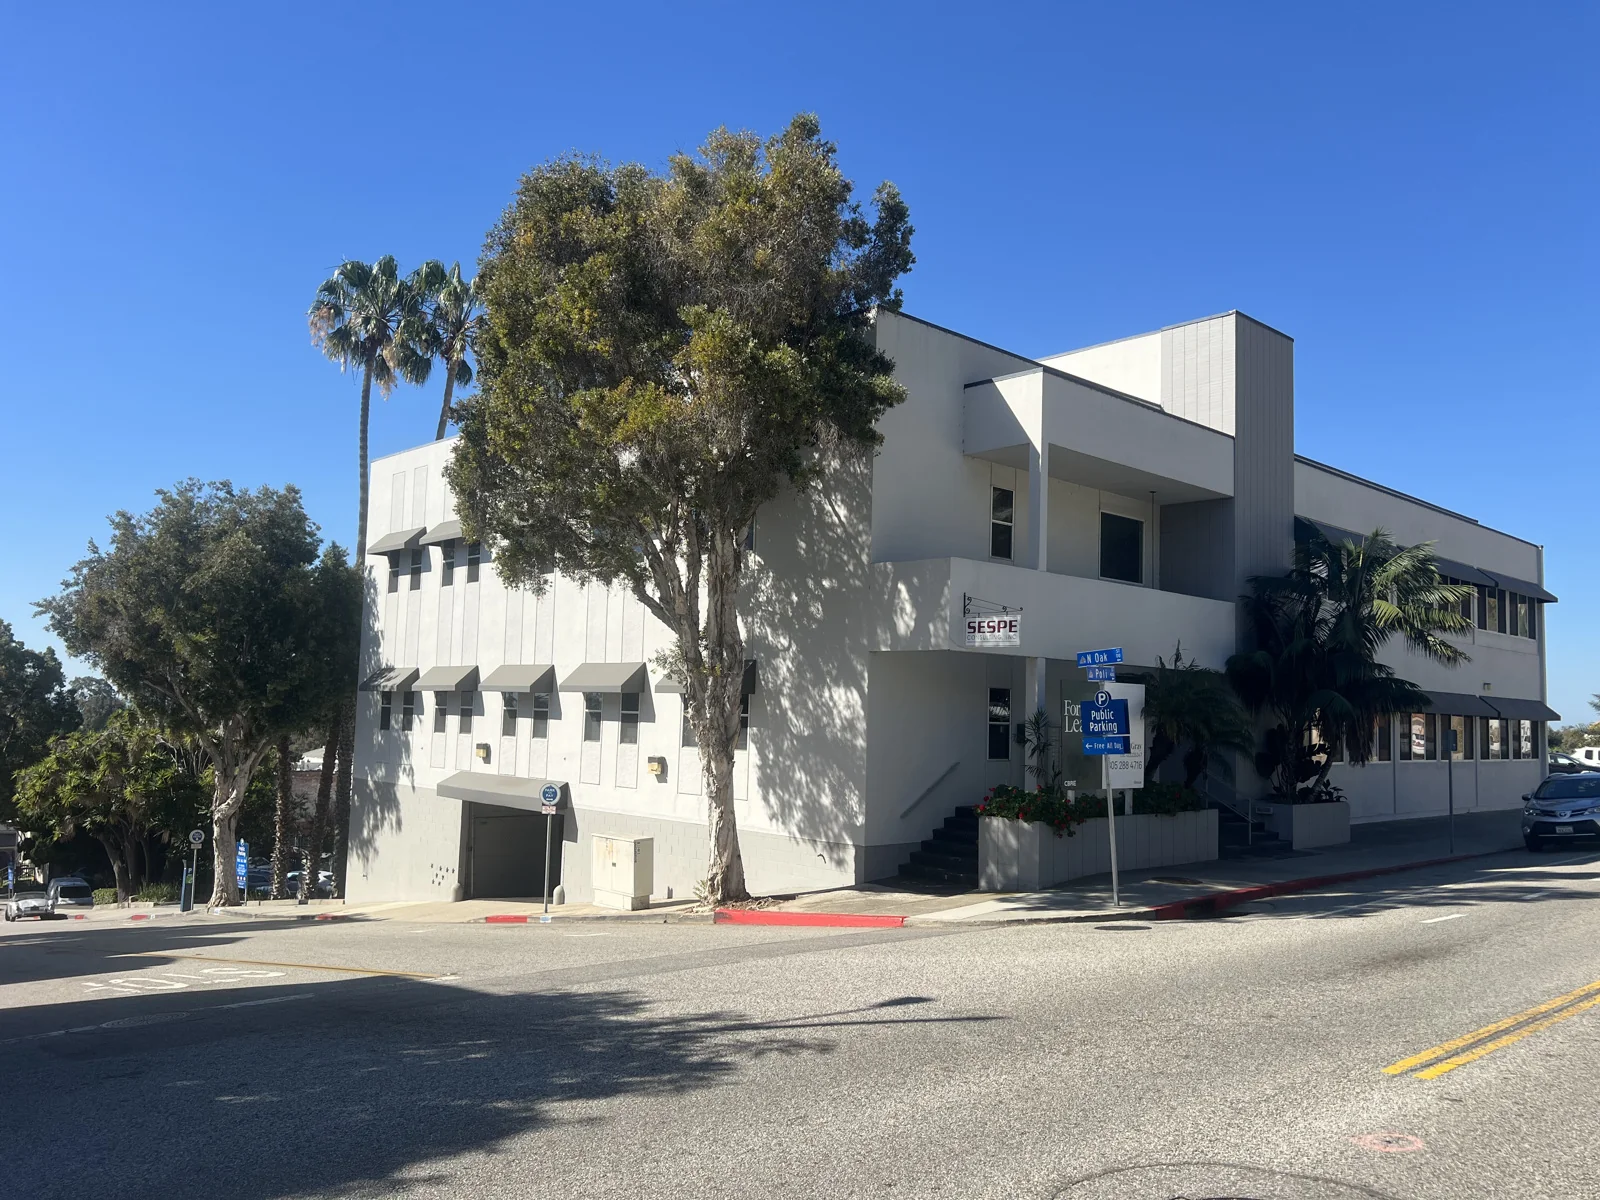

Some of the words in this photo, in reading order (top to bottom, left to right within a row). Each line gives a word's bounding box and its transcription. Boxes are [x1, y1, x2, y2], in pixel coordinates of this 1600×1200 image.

[967, 620, 1018, 634] SESPE
[1086, 653, 1092, 664] N
[1094, 652, 1108, 663] Oak
[1095, 668, 1108, 679] Poli
[1099, 693, 1106, 705] P
[1064, 699, 1081, 716] For
[1091, 710, 1115, 720] Public
[1064, 715, 1083, 733] Lea
[1089, 721, 1118, 733] Parking
[1119, 760, 1129, 770] 288
[1130, 760, 1143, 770] 4716
